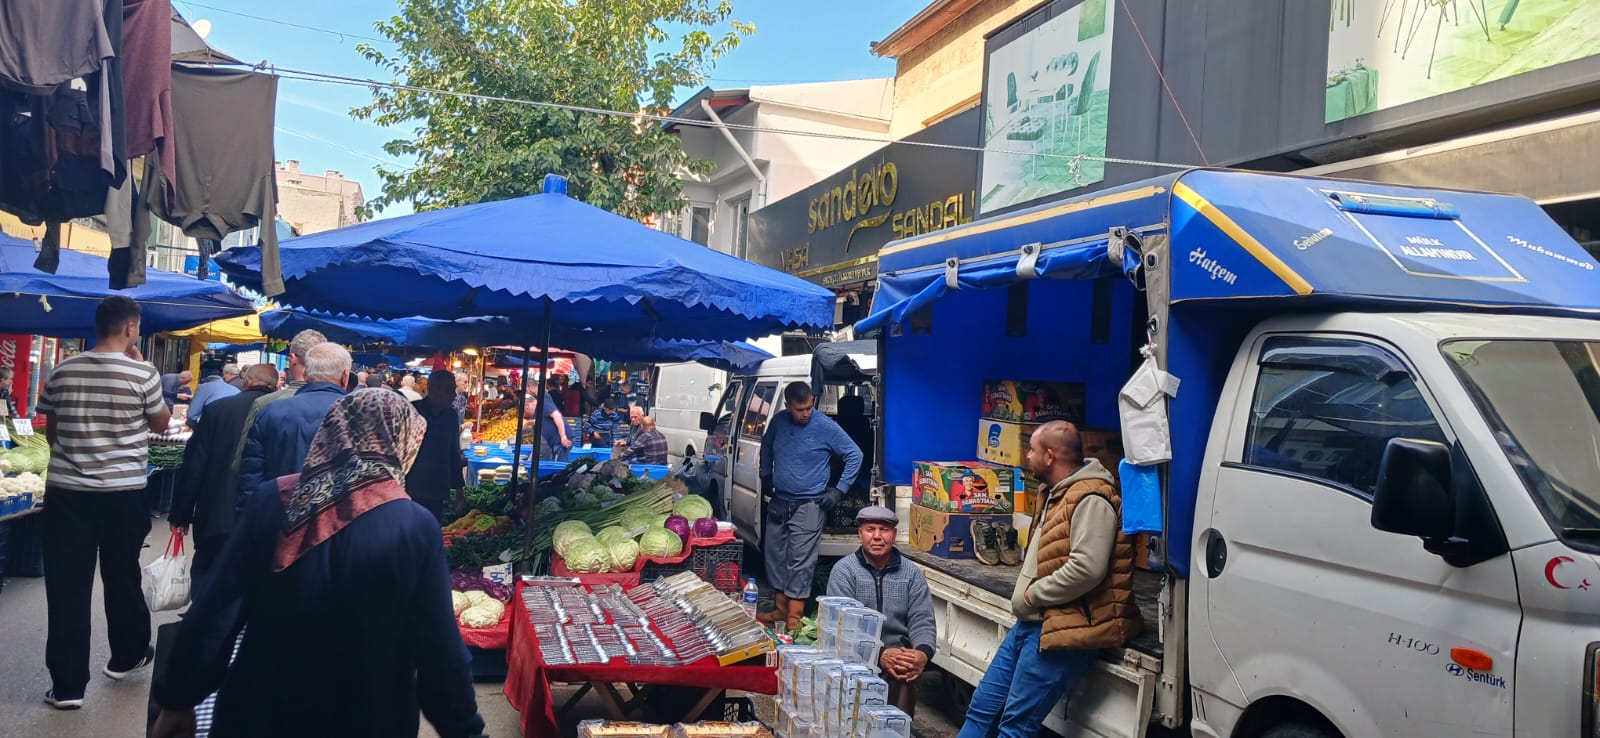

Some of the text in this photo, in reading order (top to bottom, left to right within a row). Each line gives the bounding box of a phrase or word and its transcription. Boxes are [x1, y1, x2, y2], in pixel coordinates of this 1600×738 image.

[808, 161, 898, 234] sandevo
[1189, 247, 1239, 286] Hatçem
[1387, 631, 1440, 655] H-100
[1466, 668, 1507, 689] Şentürk
